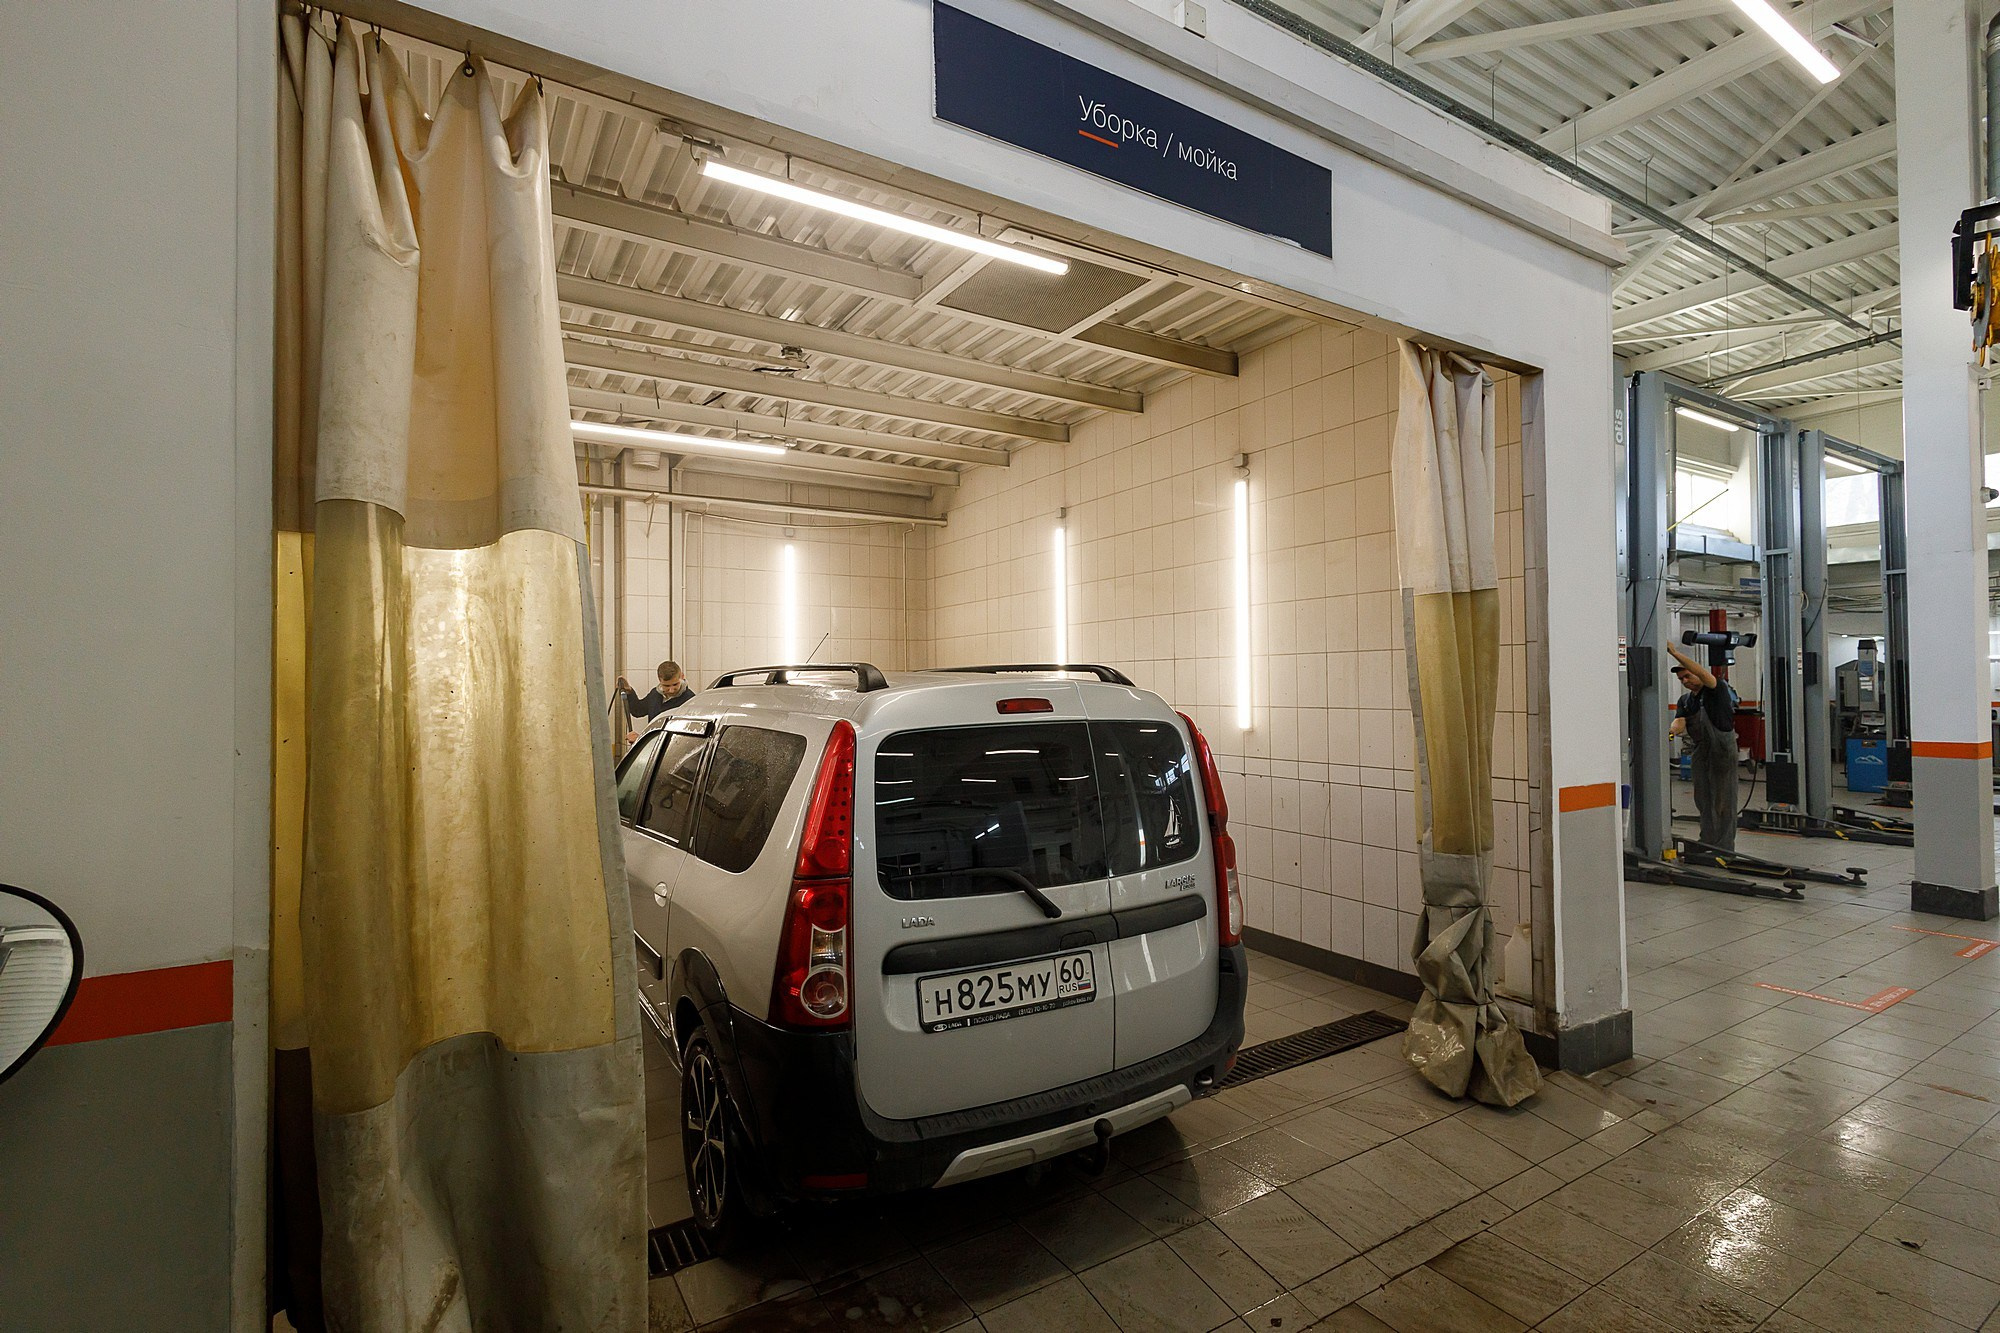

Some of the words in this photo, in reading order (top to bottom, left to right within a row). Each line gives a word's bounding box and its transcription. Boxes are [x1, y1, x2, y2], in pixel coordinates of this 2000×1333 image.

[1078, 95, 1158, 150] Уборка
[1163, 132, 1173, 158] /
[1179, 141, 1238, 181] мойка
[901, 916, 936, 929] LADA
[1059, 957, 1084, 984] 60
[1058, 982, 1078, 994] RUS
